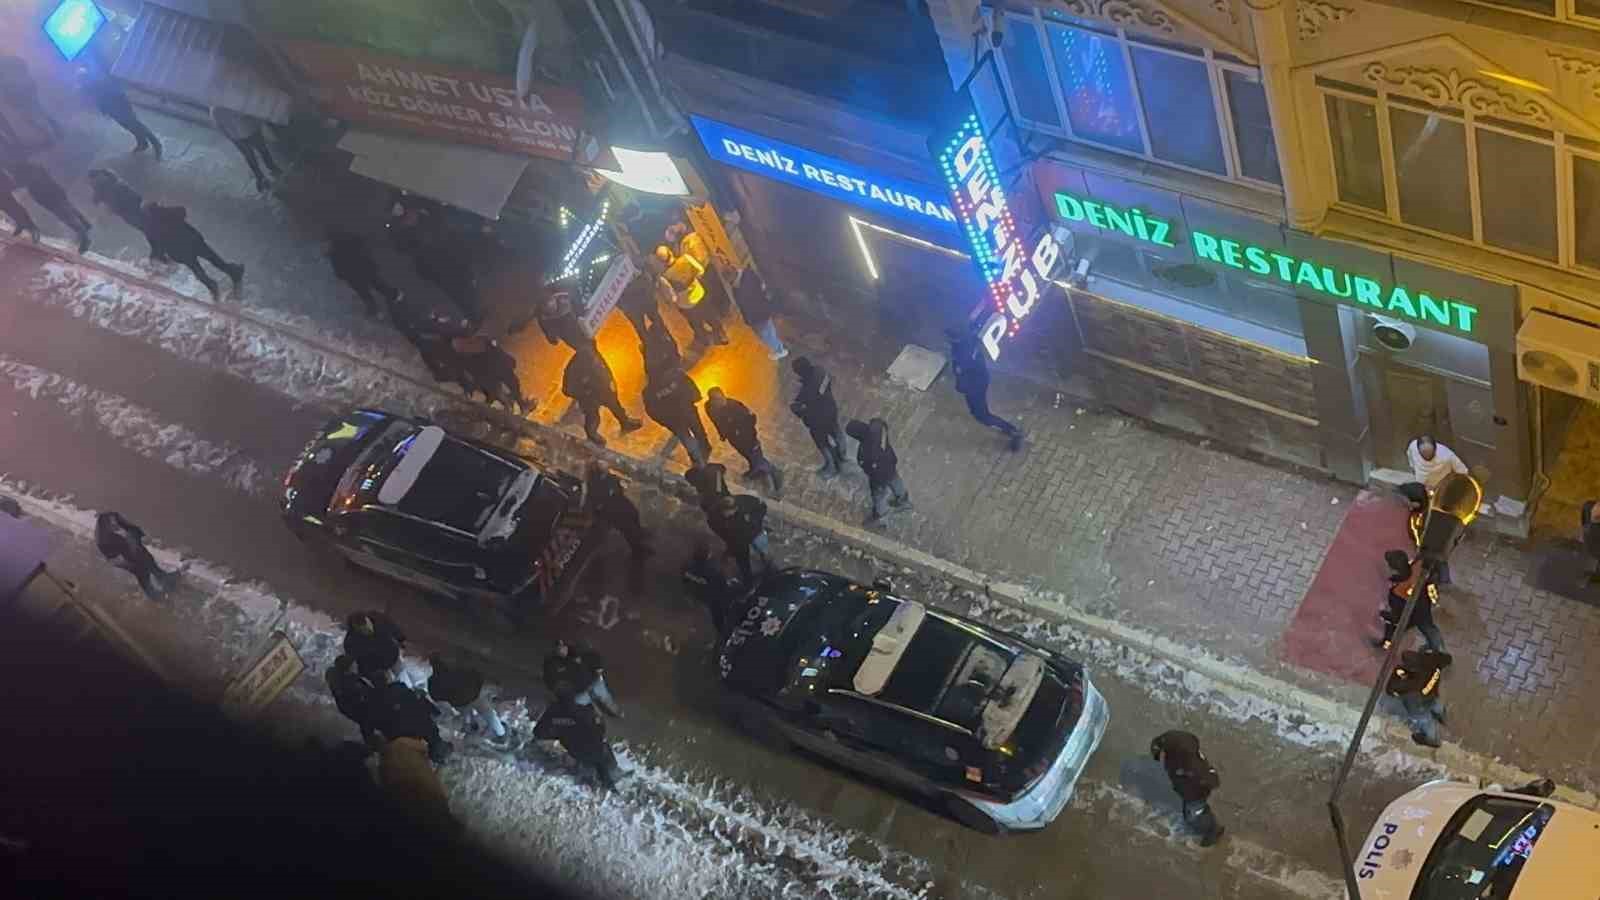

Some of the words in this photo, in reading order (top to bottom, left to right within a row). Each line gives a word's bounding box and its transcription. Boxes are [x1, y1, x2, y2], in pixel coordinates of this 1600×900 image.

[357, 64, 461, 97] AHMET
[468, 81, 552, 114] USTA
[722, 138, 800, 176] DENİZ
[802, 163, 957, 223] RESTAURAN
[982, 232, 1059, 362] PUB
[1054, 192, 1176, 249] DENİZ
[1193, 230, 1479, 333] RESTAURANT
[1359, 822, 1399, 879] POLİS
